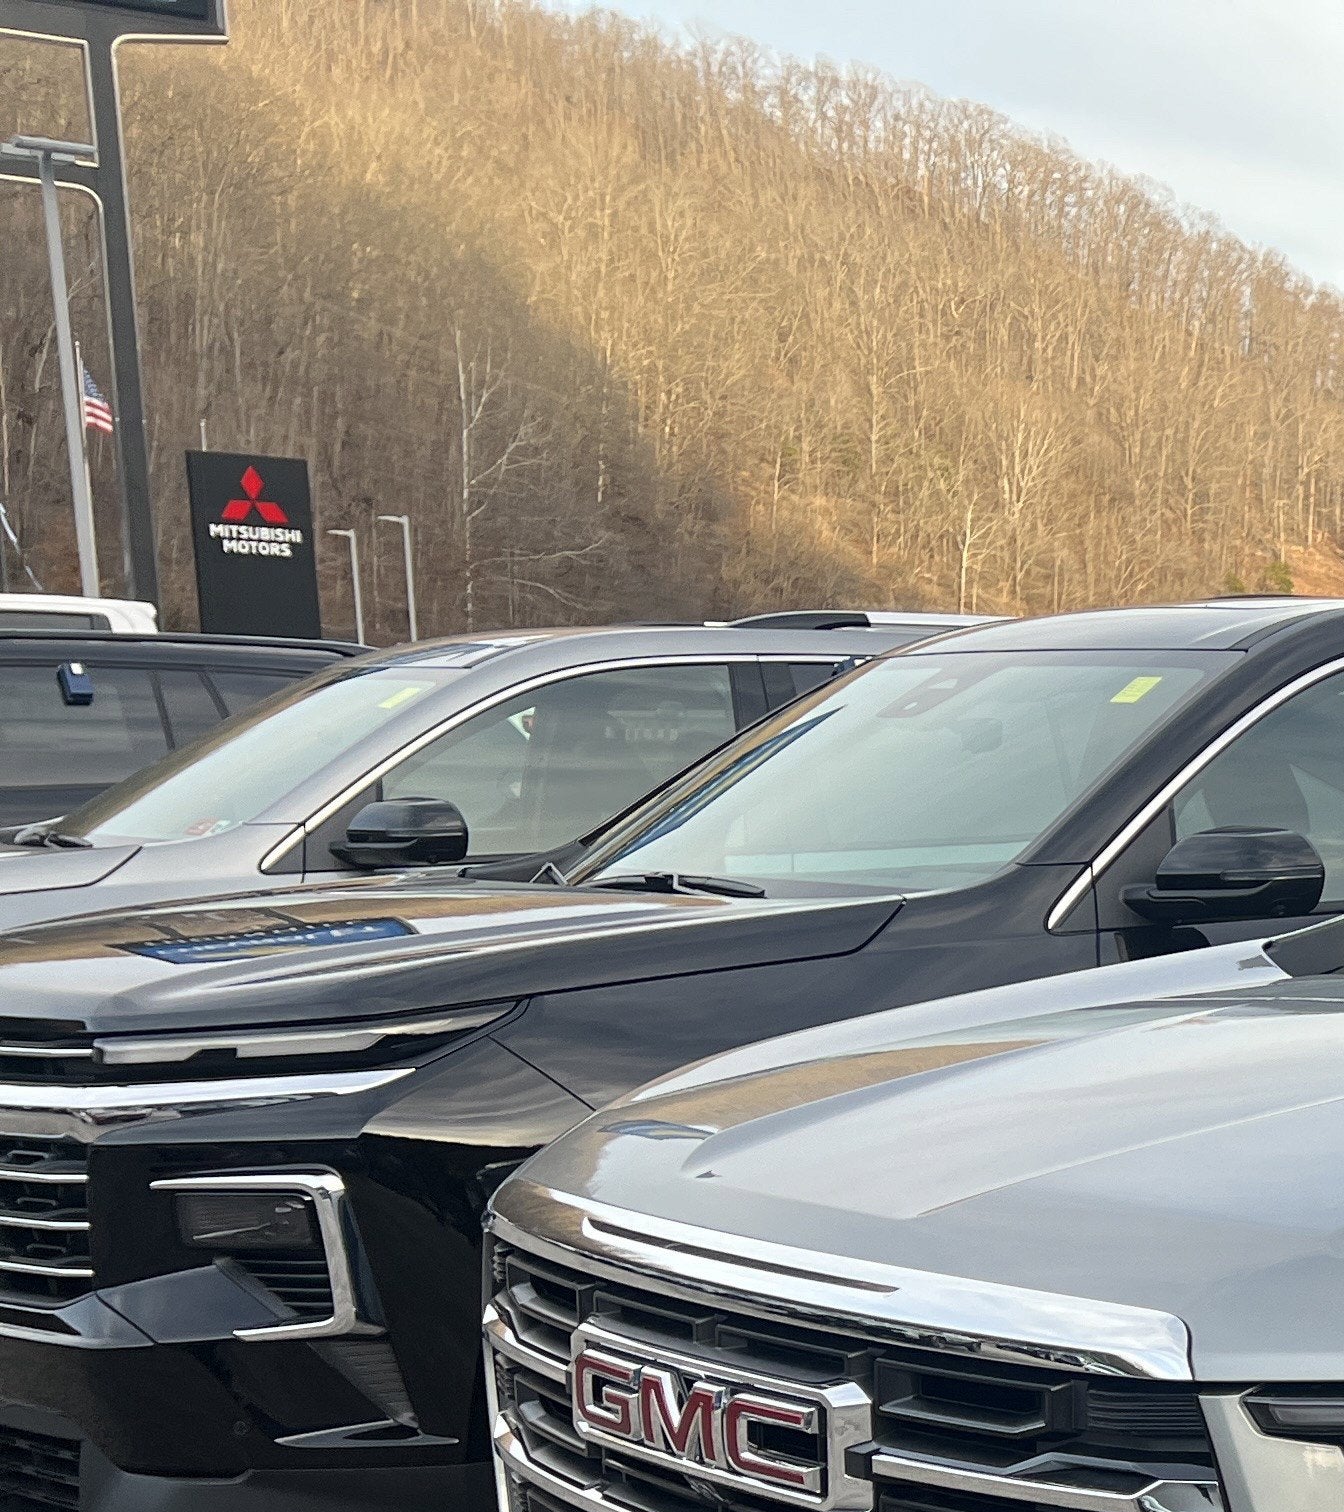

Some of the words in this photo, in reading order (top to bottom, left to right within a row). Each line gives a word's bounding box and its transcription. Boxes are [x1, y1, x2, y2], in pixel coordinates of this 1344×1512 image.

[208, 523, 303, 543] MITSUBISHI
[222, 539, 293, 557] MOTORS
[575, 1349, 822, 1494] GMC
